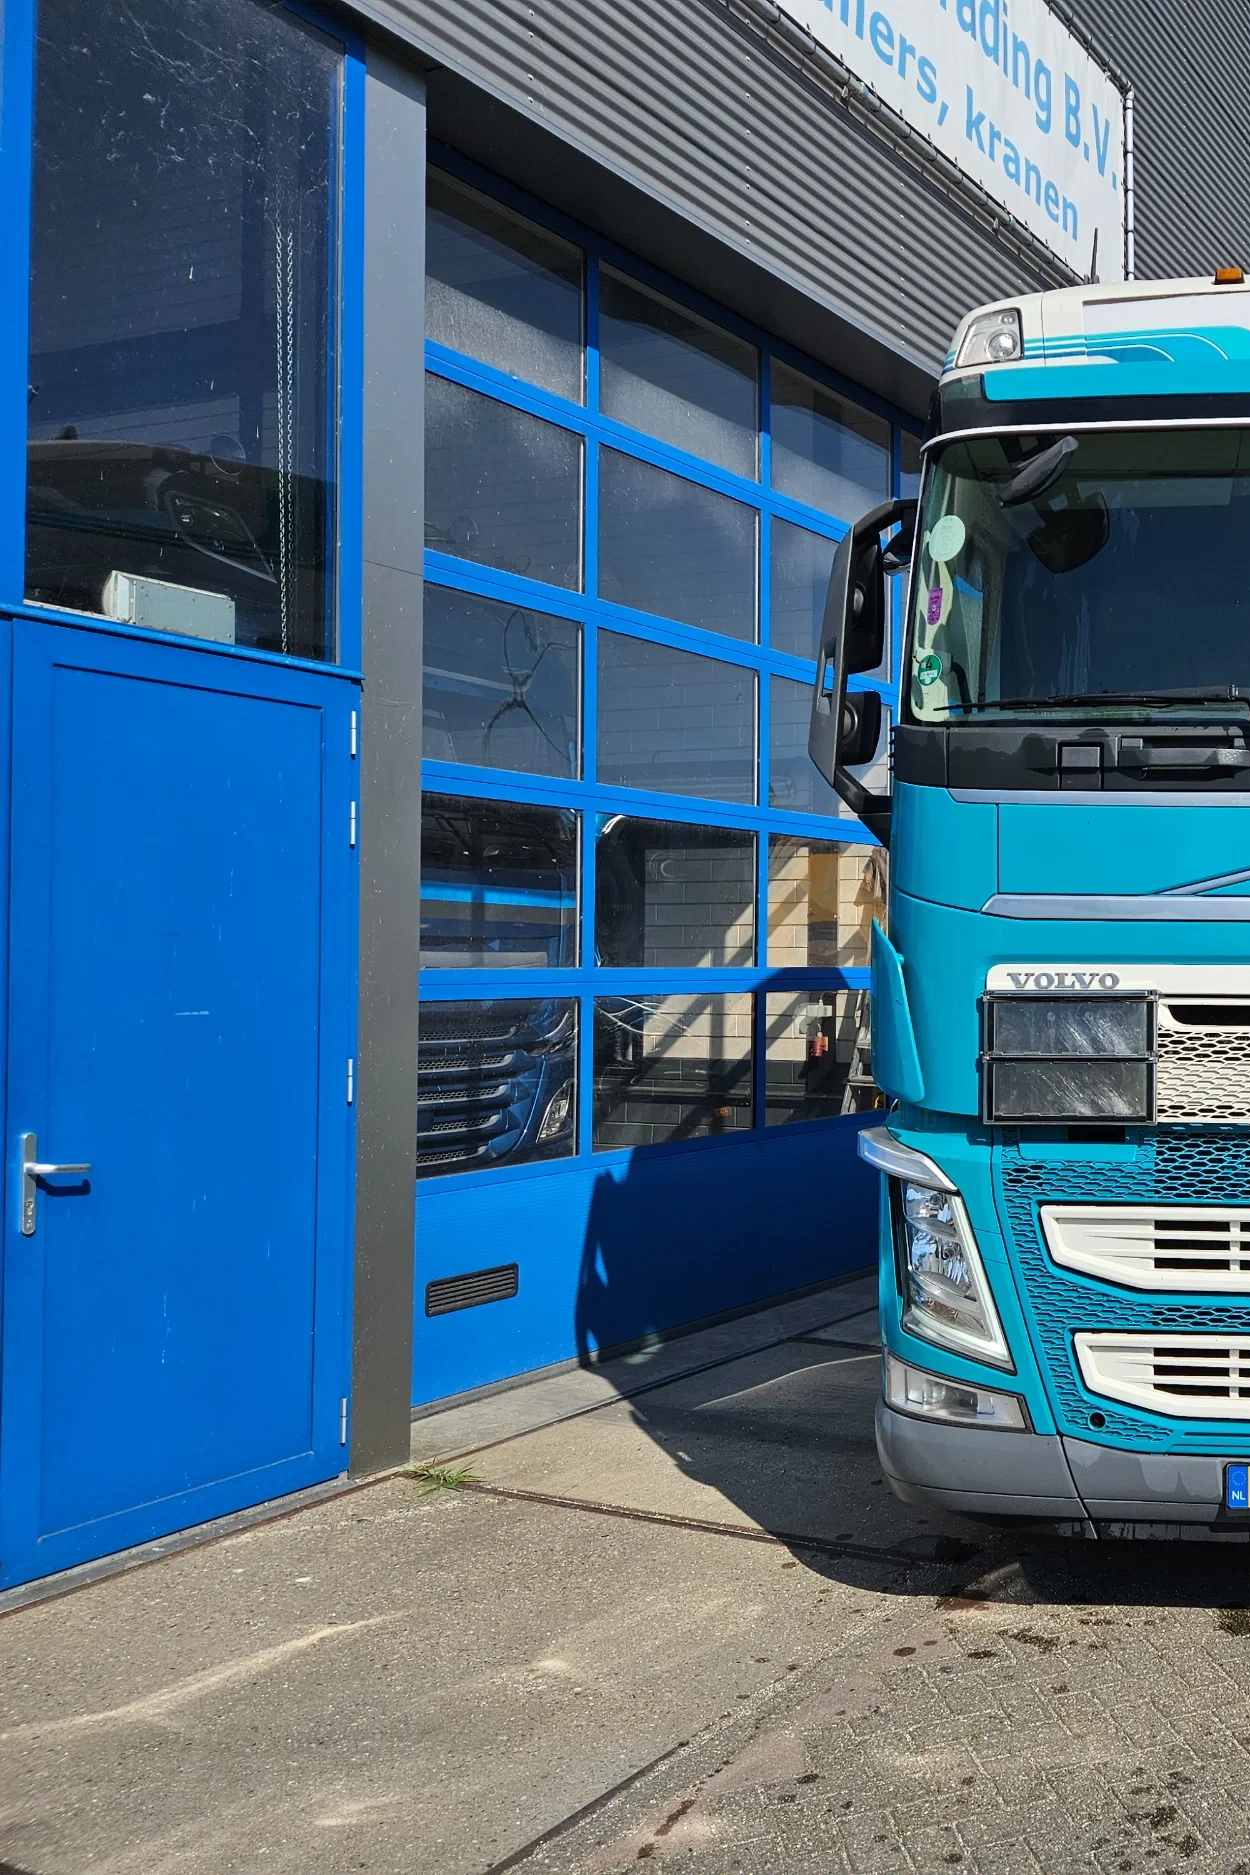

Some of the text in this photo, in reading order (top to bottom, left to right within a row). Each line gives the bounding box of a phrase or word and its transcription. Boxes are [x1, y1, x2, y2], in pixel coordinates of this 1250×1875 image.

[940, 0, 1117, 191] ading B.V.
[965, 84, 1078, 242] kranen
[925, 656, 933, 670] 4
[1006, 972, 1120, 989] VOLVO
[1231, 1490, 1246, 1500] NL
